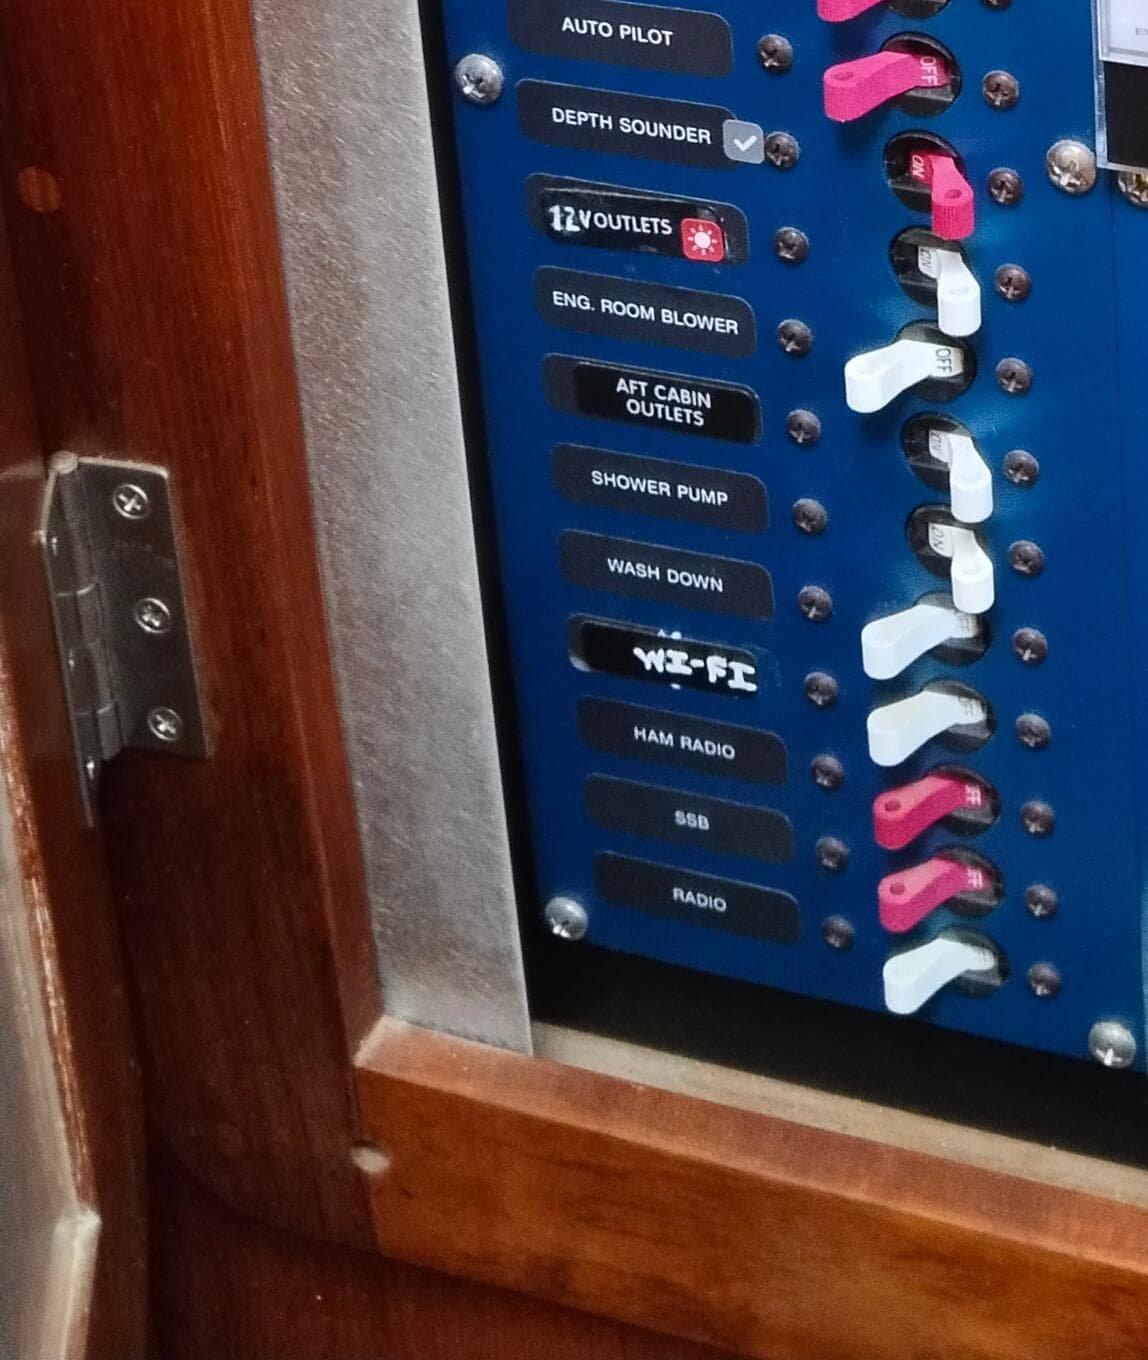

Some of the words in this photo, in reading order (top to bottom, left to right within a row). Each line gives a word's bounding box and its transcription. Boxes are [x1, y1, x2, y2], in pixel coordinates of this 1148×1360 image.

[561, 16, 613, 38] AUTO
[619, 24, 674, 46] PILOT
[920, 56, 938, 86] OFF
[552, 107, 613, 130] DEPTH
[619, 118, 711, 145] SOUNDER
[552, 291, 595, 313] ENG.
[600, 298, 655, 322] ROOM
[661, 306, 739, 336] BLOWER
[935, 348, 952, 374] OFF
[616, 378, 649, 397] AFT
[654, 384, 711, 408] CABIN
[626, 399, 705, 427] OUTLETS
[591, 469, 671, 497] SHOWER
[677, 483, 728, 506] PUMP
[608, 558, 660, 581] WASH
[667, 567, 723, 593] DOWN
[633, 647, 757, 692] WI-FI
[633, 726, 673, 747] HAM
[680, 734, 736, 760] RADIO
[674, 810, 710, 831] SSB
[672, 887, 727, 913] RADIO
